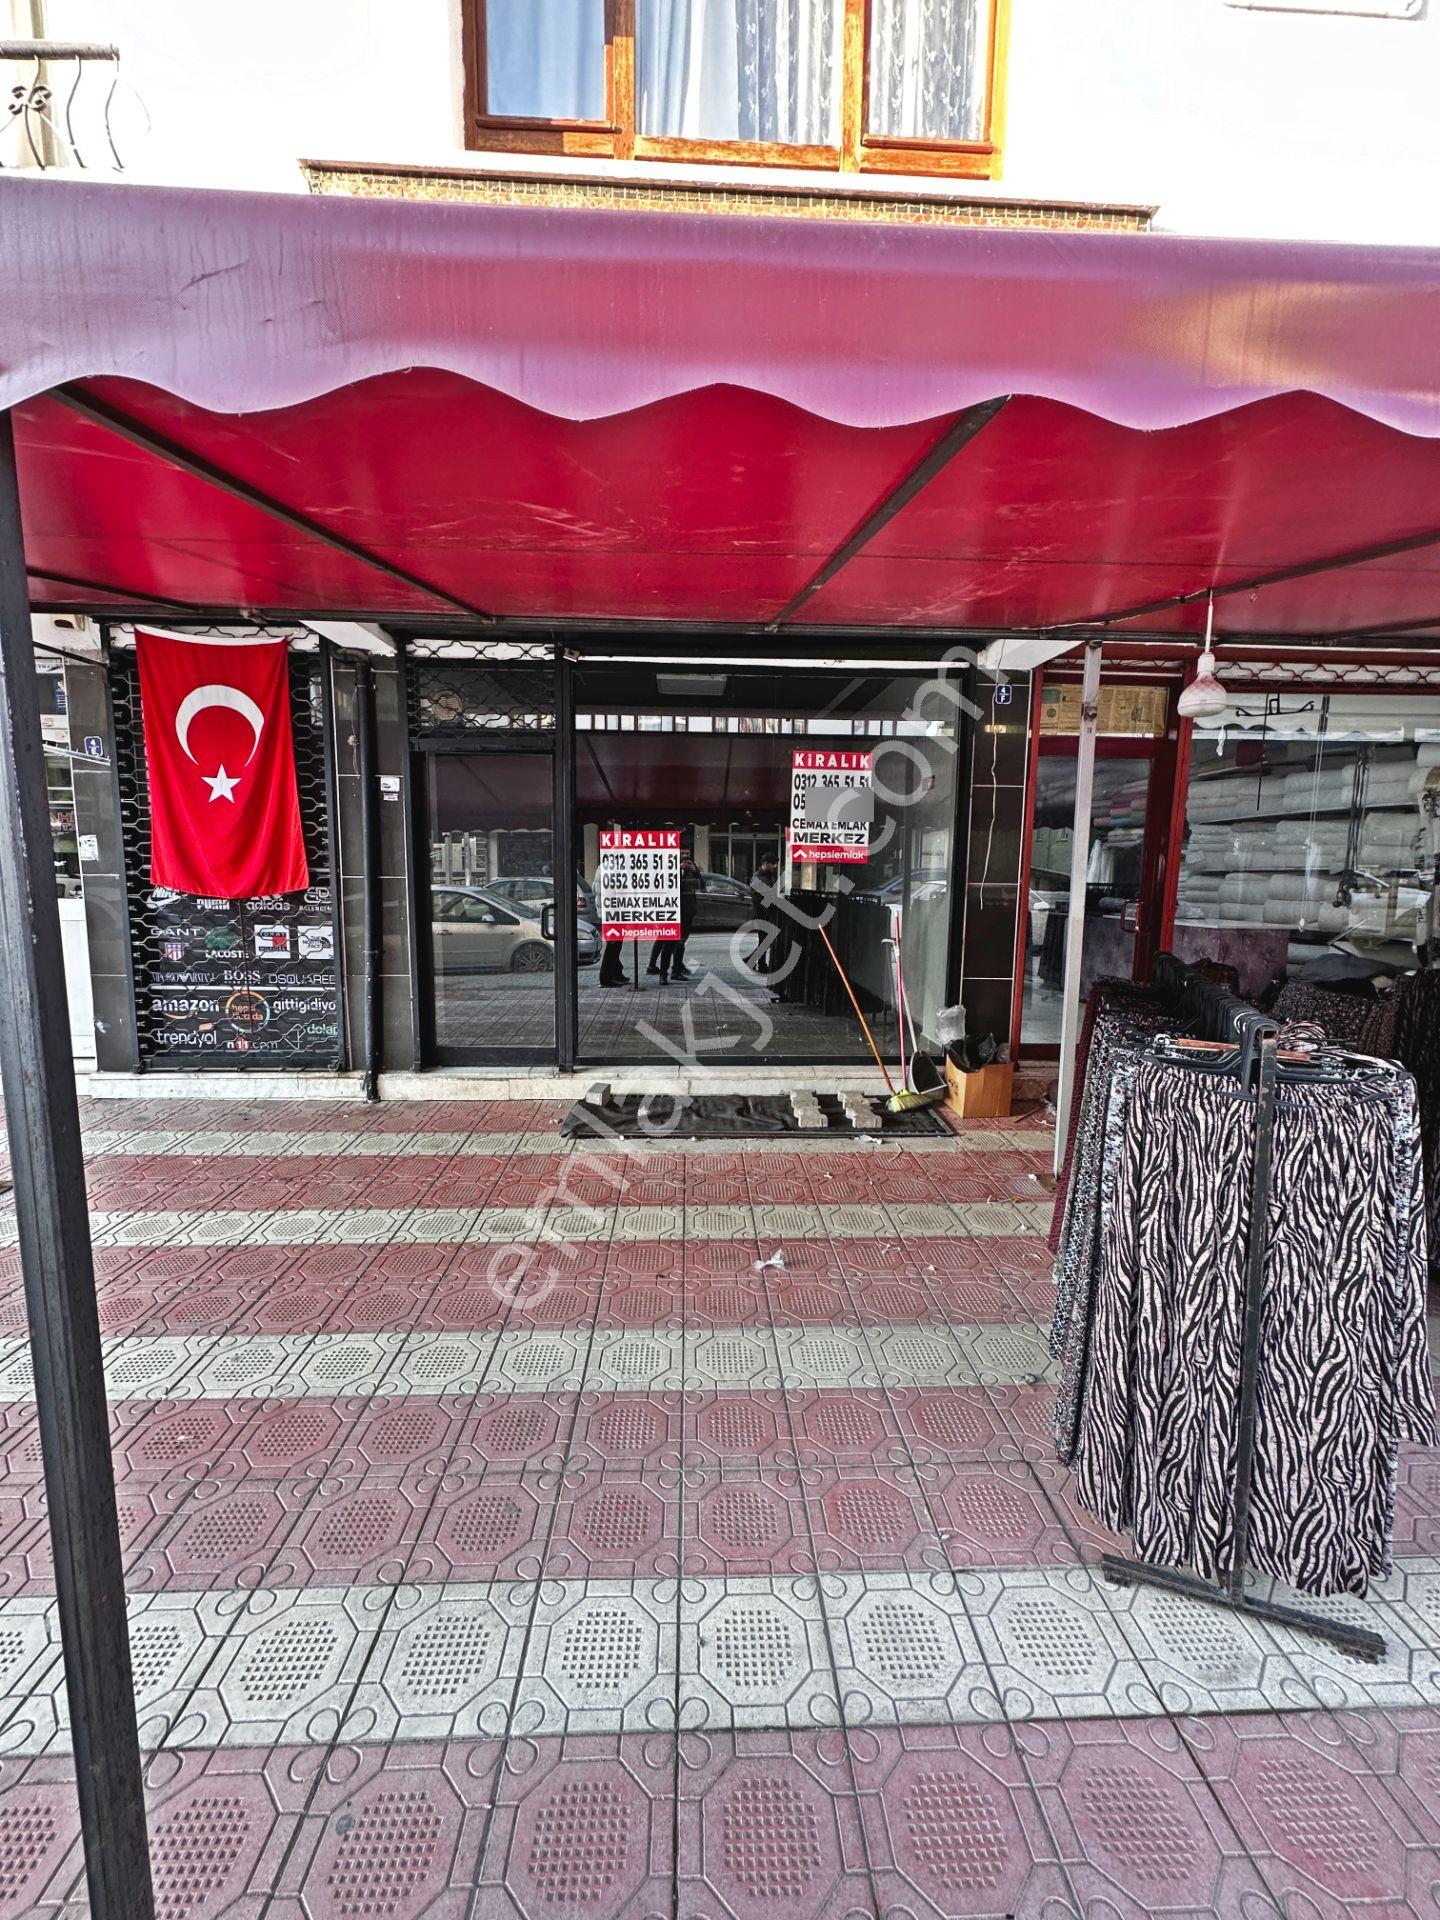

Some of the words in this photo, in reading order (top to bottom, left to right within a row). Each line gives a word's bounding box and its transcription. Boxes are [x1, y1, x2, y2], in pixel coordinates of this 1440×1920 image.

[794, 832, 864, 844] MERKEZ
[602, 854, 626, 870] 0312
[630, 854, 648, 870] 365
[653, 854, 662, 870] 51
[668, 854, 677, 870] 51
[603, 873, 628, 889] 0552
[631, 873, 650, 889] 865
[654, 873, 664, 889] 61
[668, 873, 677, 889] 51
[246, 899, 290, 911] adidas
[603, 897, 640, 908] CEMAX
[643, 897, 678, 908] EMLAK
[606, 911, 677, 921] MERKEZ
[151, 928, 200, 936] GANT
[224, 970, 261, 981] BOSS
[152, 999, 219, 1012] amazon
[273, 998, 336, 1013] gittigidiyo
[157, 1030, 217, 1047] trendyol
